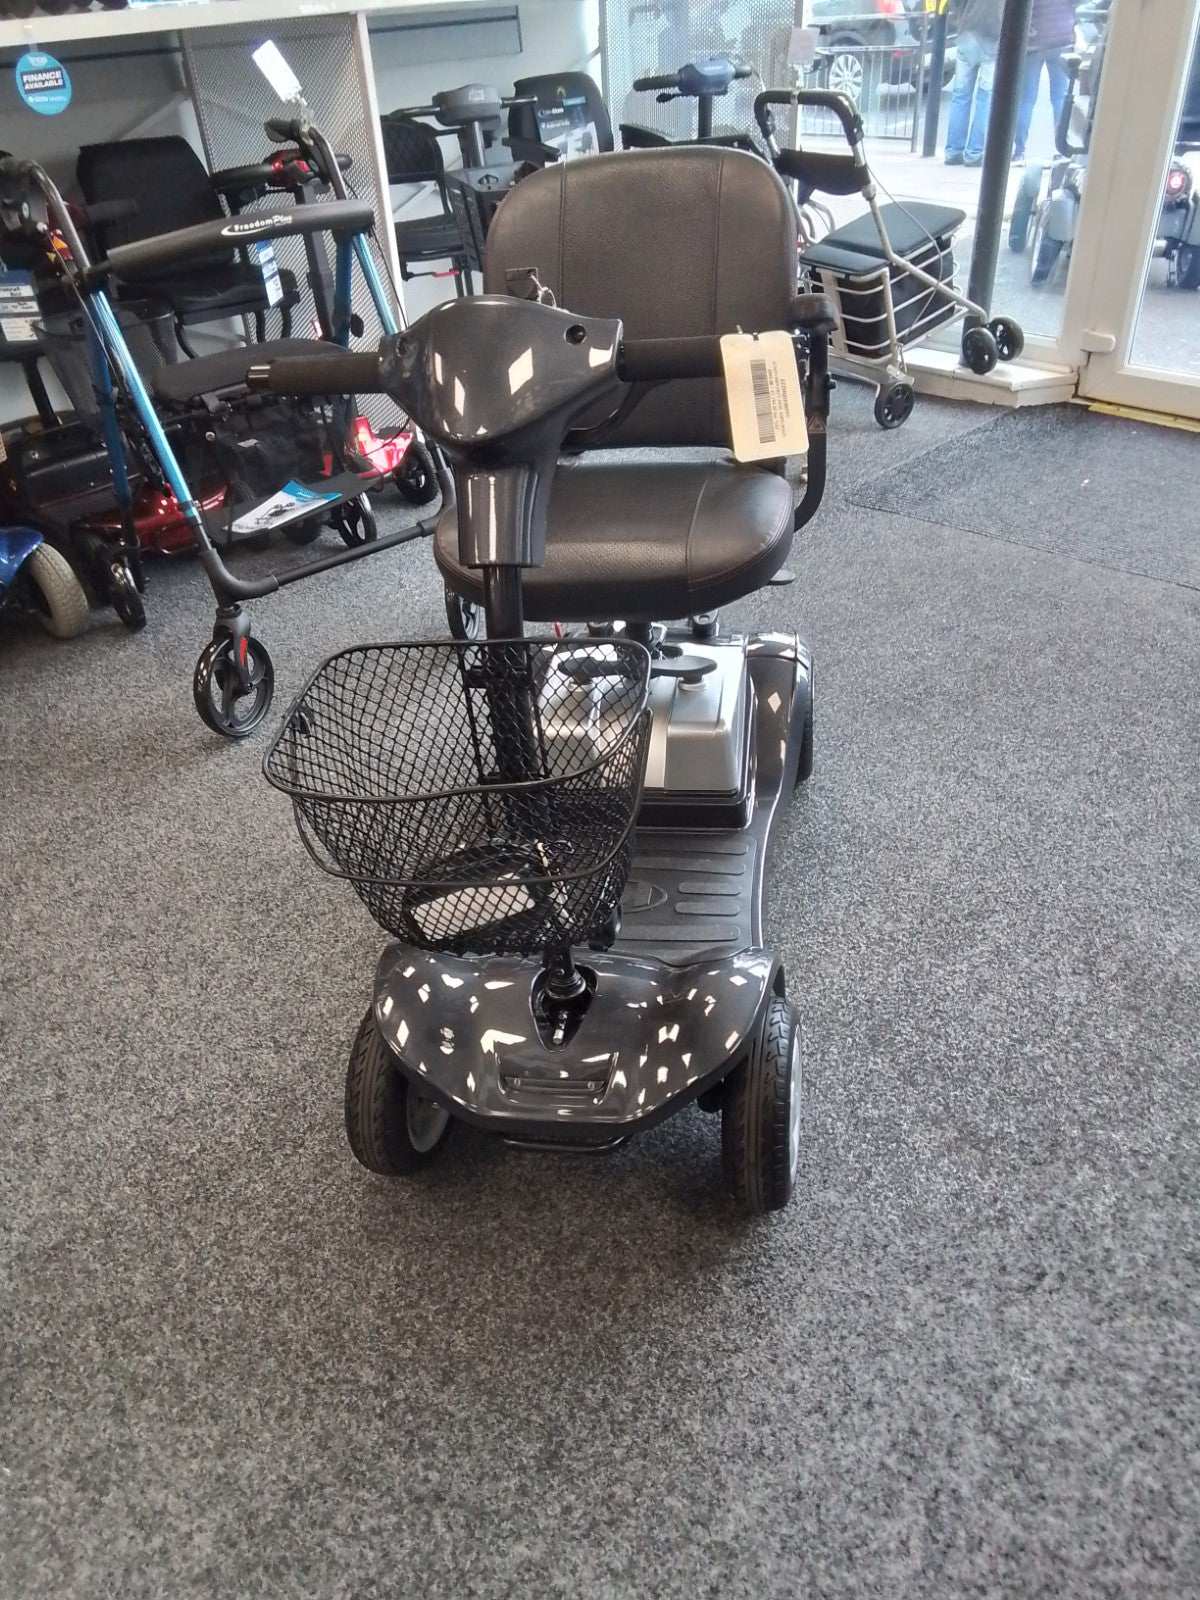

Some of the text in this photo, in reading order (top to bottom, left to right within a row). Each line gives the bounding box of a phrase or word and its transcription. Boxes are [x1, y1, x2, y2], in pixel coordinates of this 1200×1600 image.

[22, 70, 62, 83] FINANCE
[24, 78, 64, 90] AVAILABLE
[233, 218, 273, 232] Freedom
